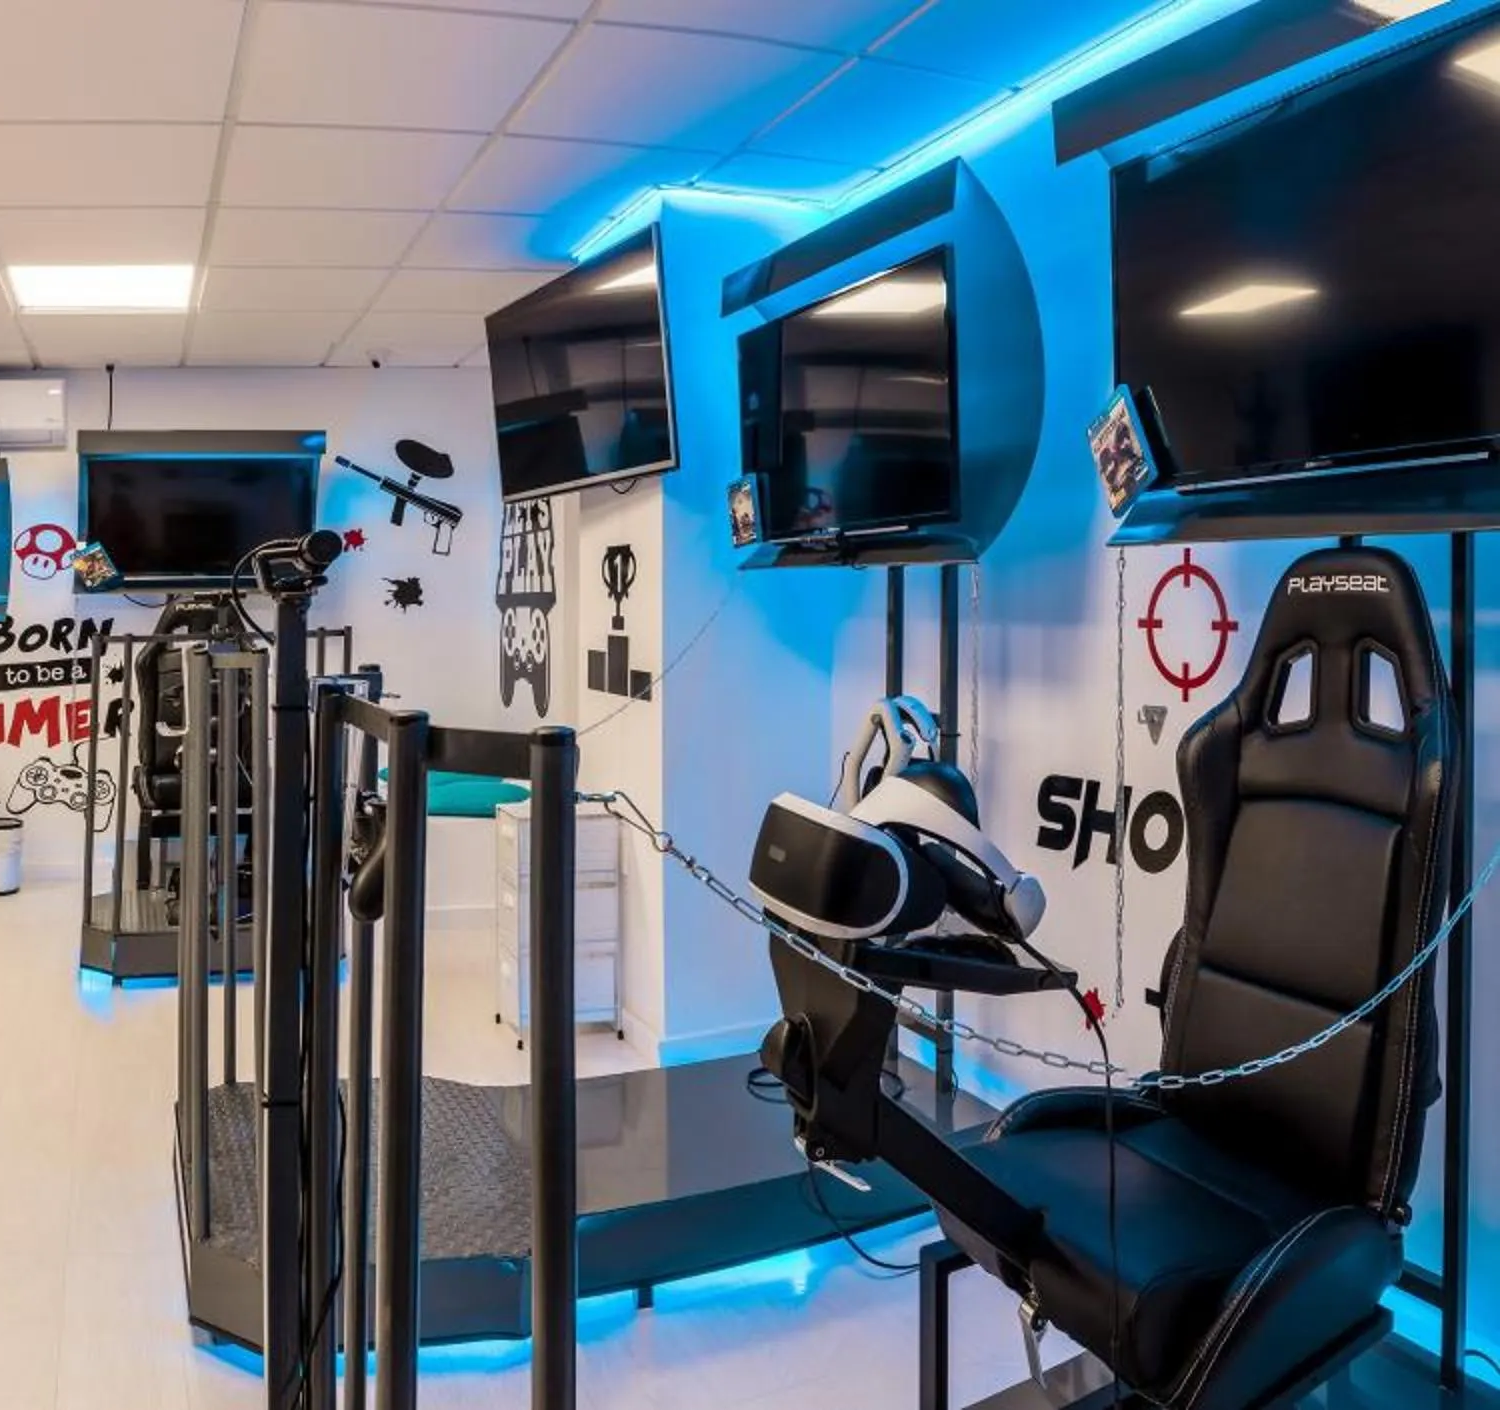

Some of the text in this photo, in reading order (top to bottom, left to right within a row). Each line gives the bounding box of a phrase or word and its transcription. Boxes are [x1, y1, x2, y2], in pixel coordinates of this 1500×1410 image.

[497, 529, 554, 595] PLAY
[5, 664, 88, 685] to be a
